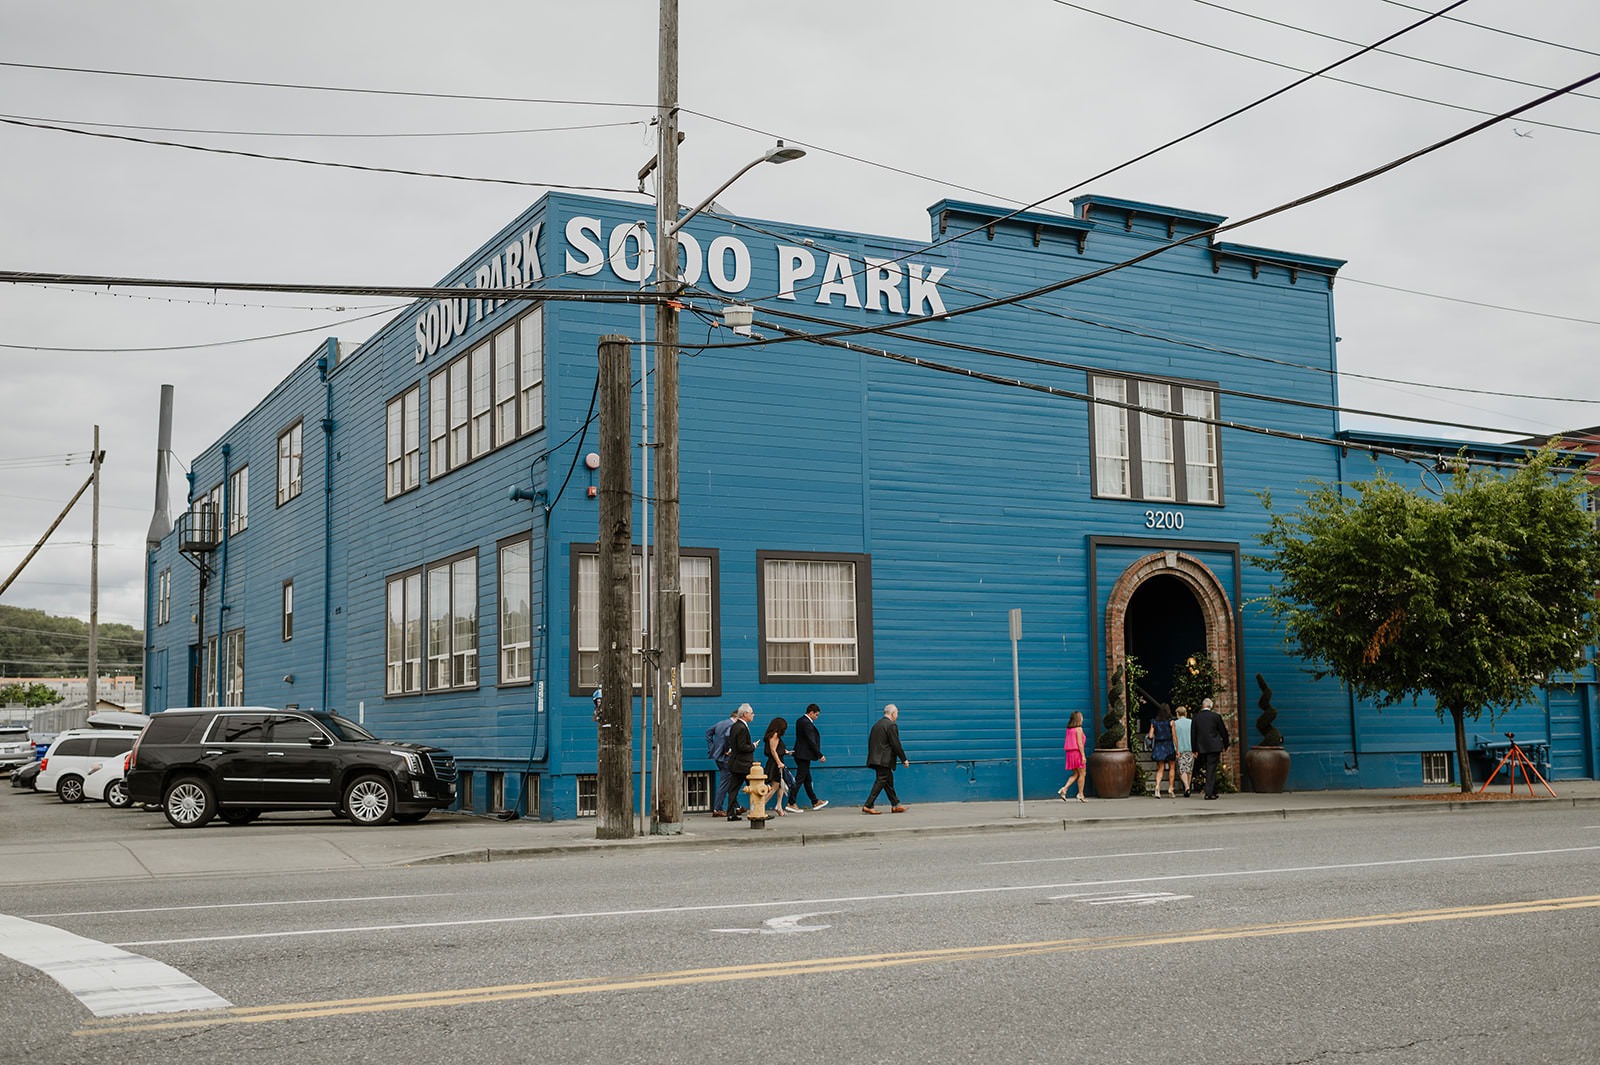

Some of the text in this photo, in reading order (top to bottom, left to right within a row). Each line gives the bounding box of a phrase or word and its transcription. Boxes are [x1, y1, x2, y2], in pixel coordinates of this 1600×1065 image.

[416, 222, 543, 364] SODO PARK
[777, 244, 949, 319] PARK
[1145, 510, 1184, 529] 3200
